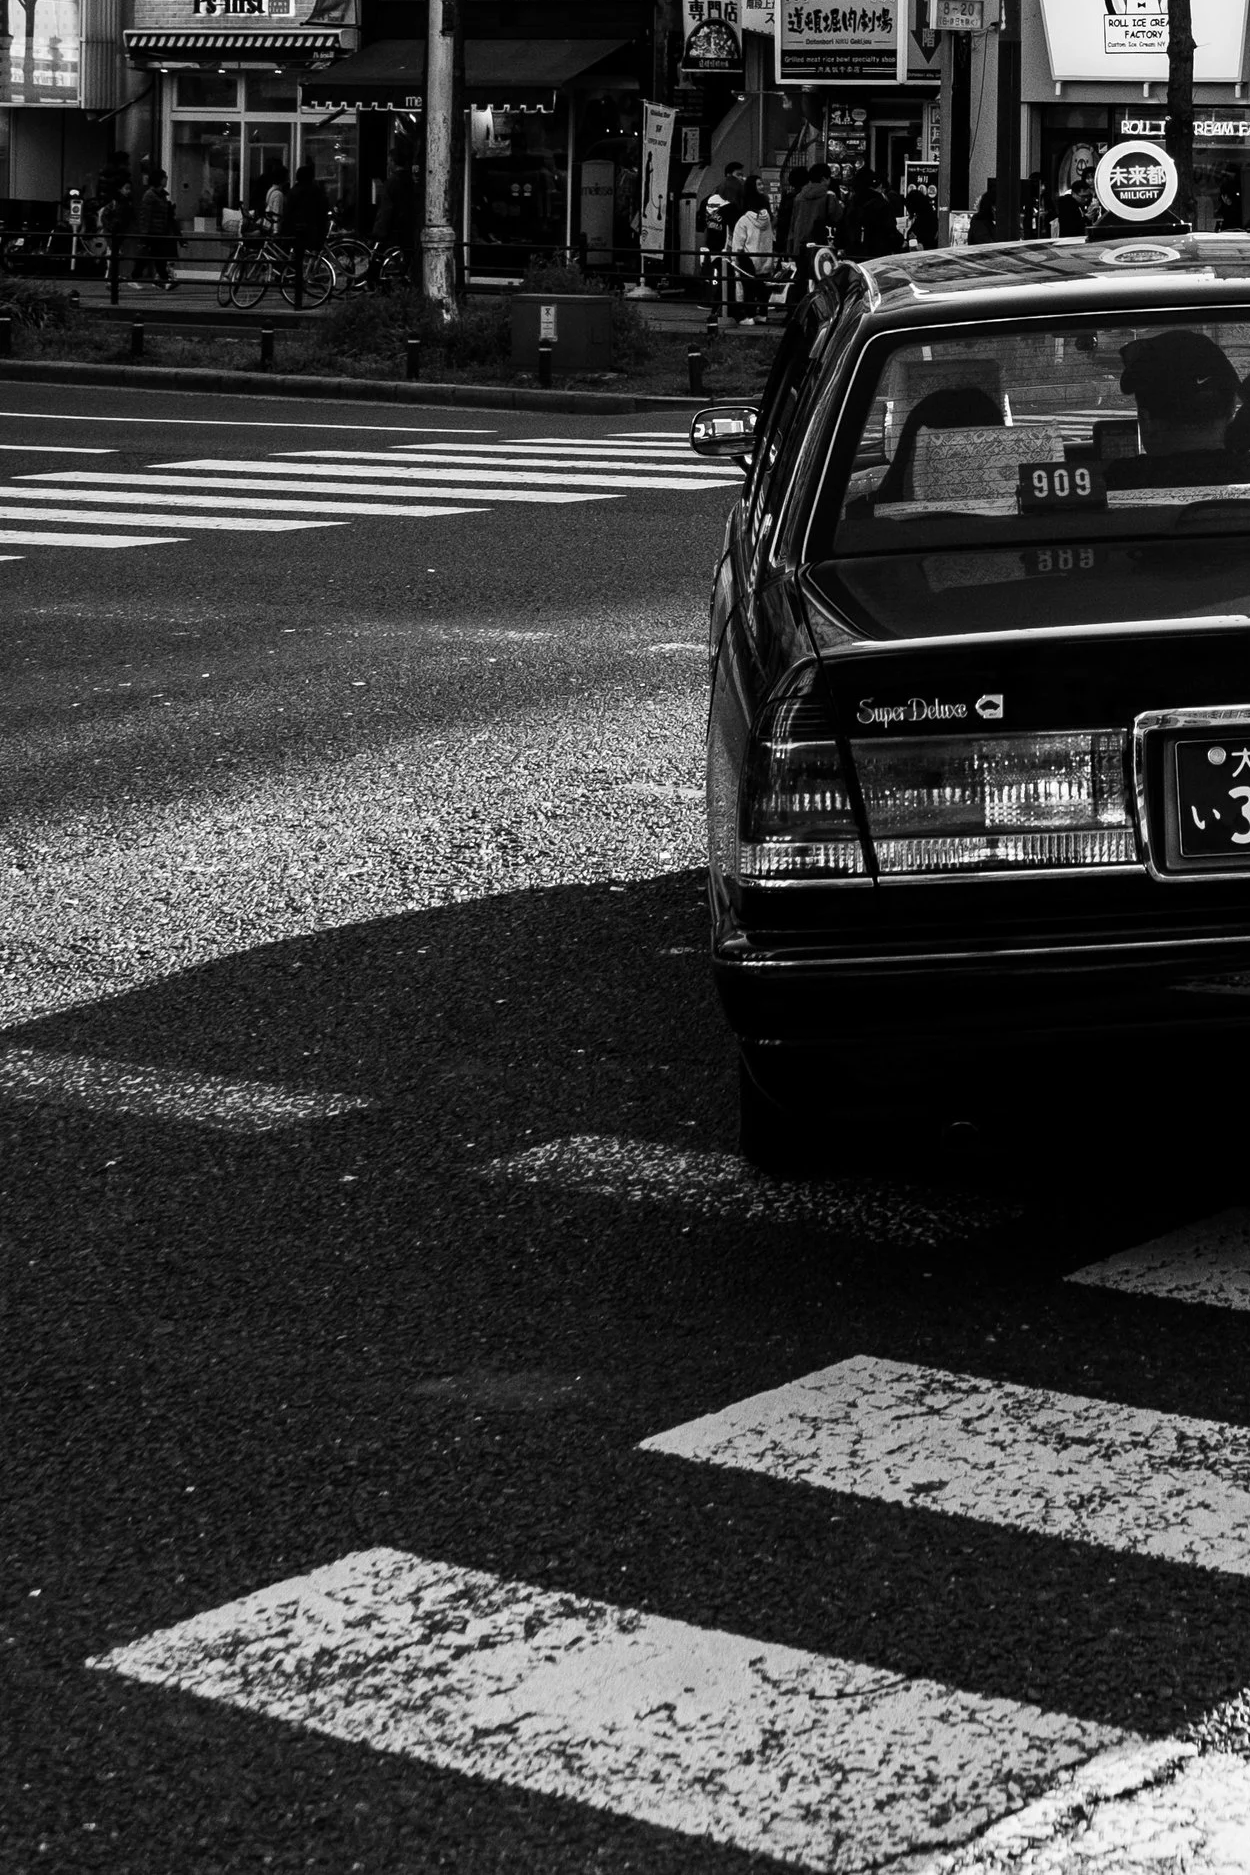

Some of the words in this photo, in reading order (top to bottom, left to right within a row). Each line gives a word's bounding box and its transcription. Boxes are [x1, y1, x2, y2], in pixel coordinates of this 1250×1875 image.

[687, 0, 738, 23] 専門店
[788, 6, 893, 35] 道頓堀肉劇場
[943, 1, 975, 17] 8-20
[1108, 18, 1129, 27] ROLL
[1132, 18, 1147, 27] ICE
[1124, 30, 1163, 39] FACTORY
[1120, 120, 1150, 135] ROLL
[1193, 121, 1235, 137] REAM
[1110, 163, 1168, 187] 未来都
[1119, 188, 1160, 201] MILIGHT
[1032, 468, 1092, 498] 909
[856, 697, 907, 728] Super
[908, 697, 968, 722] Deluxe
[1191, 805, 1221, 830] い
